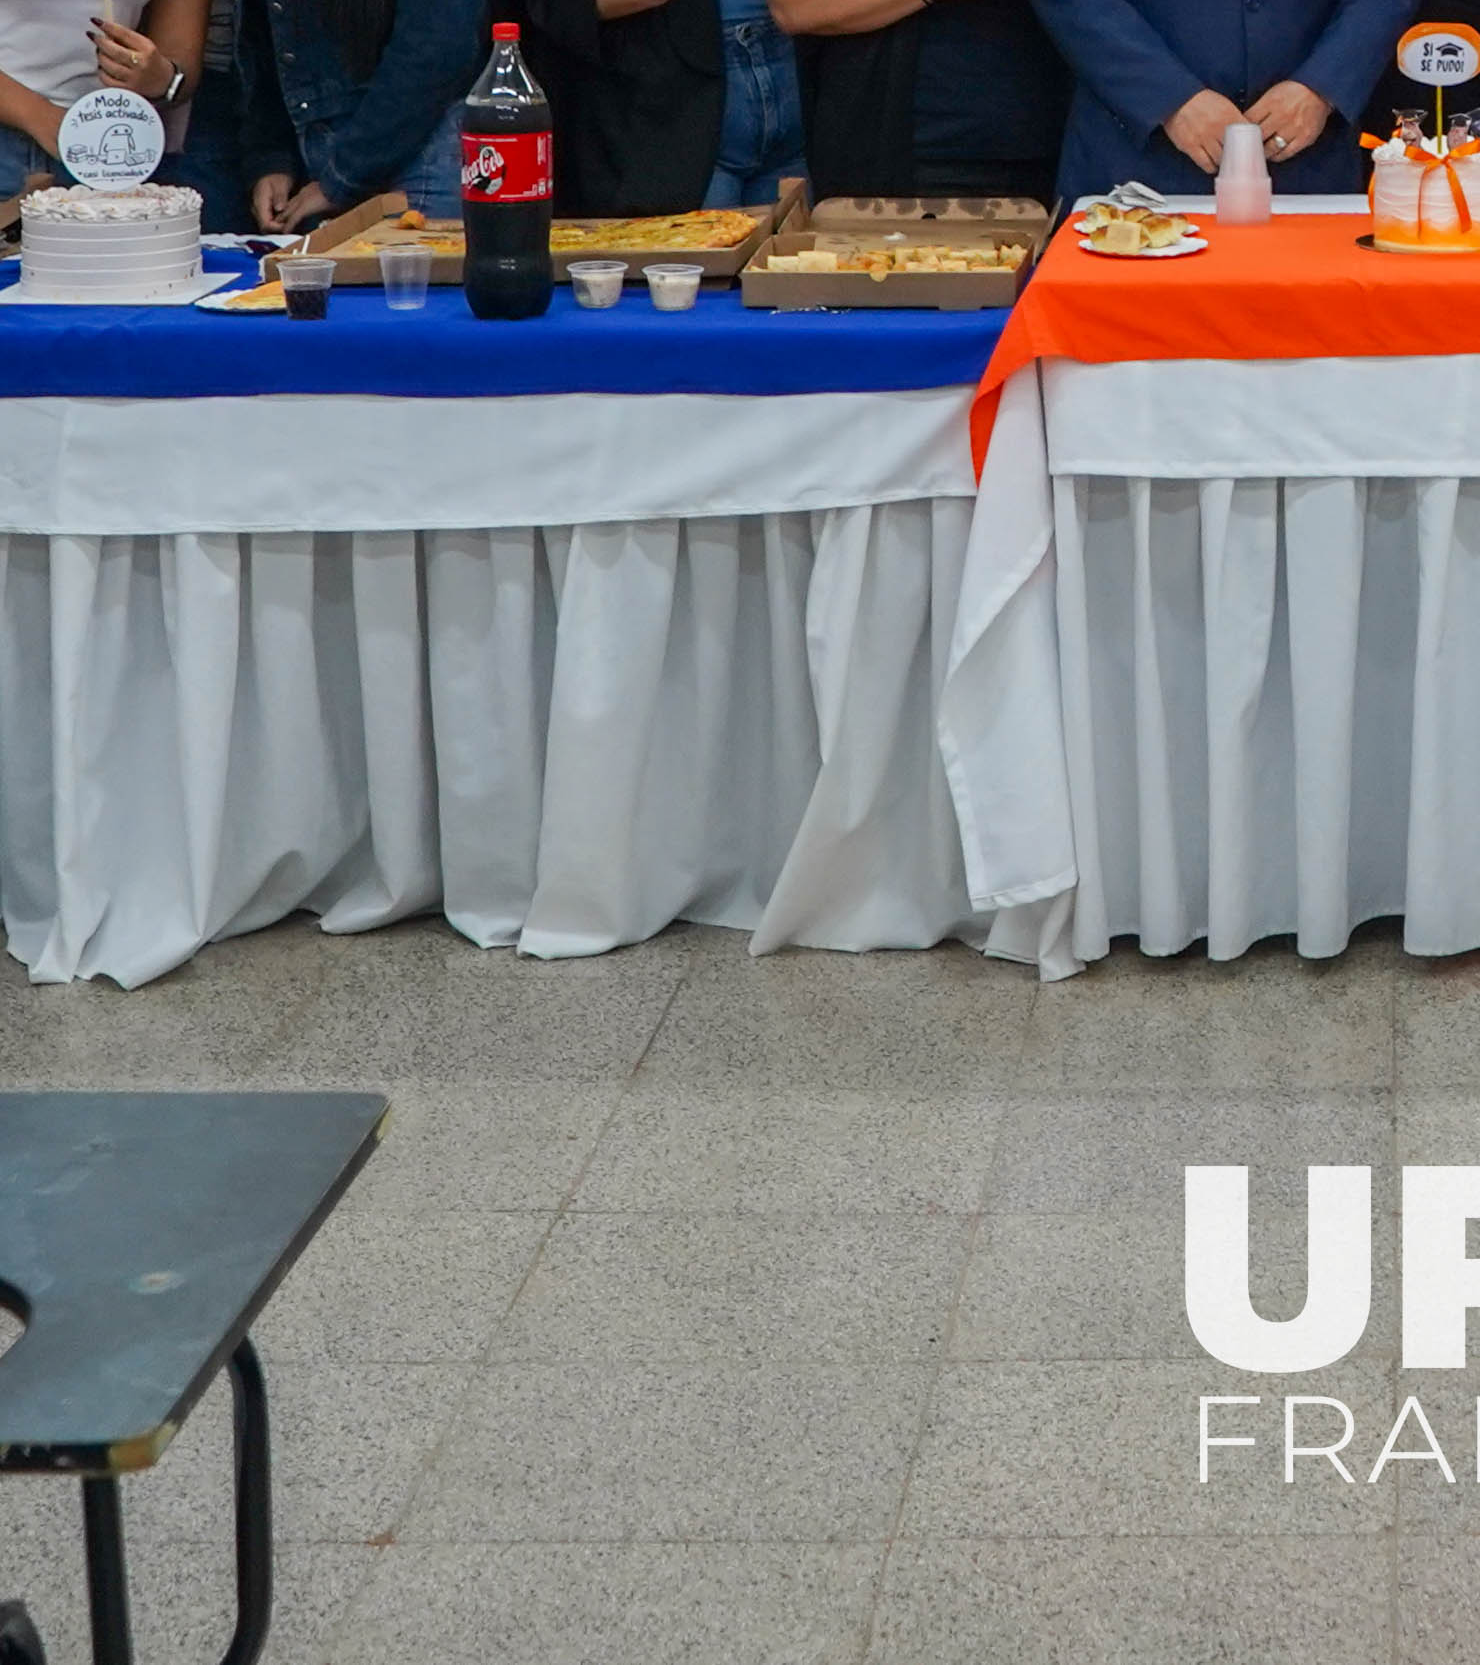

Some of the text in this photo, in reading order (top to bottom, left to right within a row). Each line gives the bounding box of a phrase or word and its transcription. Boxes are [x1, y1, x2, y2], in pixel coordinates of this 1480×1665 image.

[1421, 59, 1432, 72] SE
[95, 94, 131, 108] Modo
[79, 109, 149, 123] tesis activado
